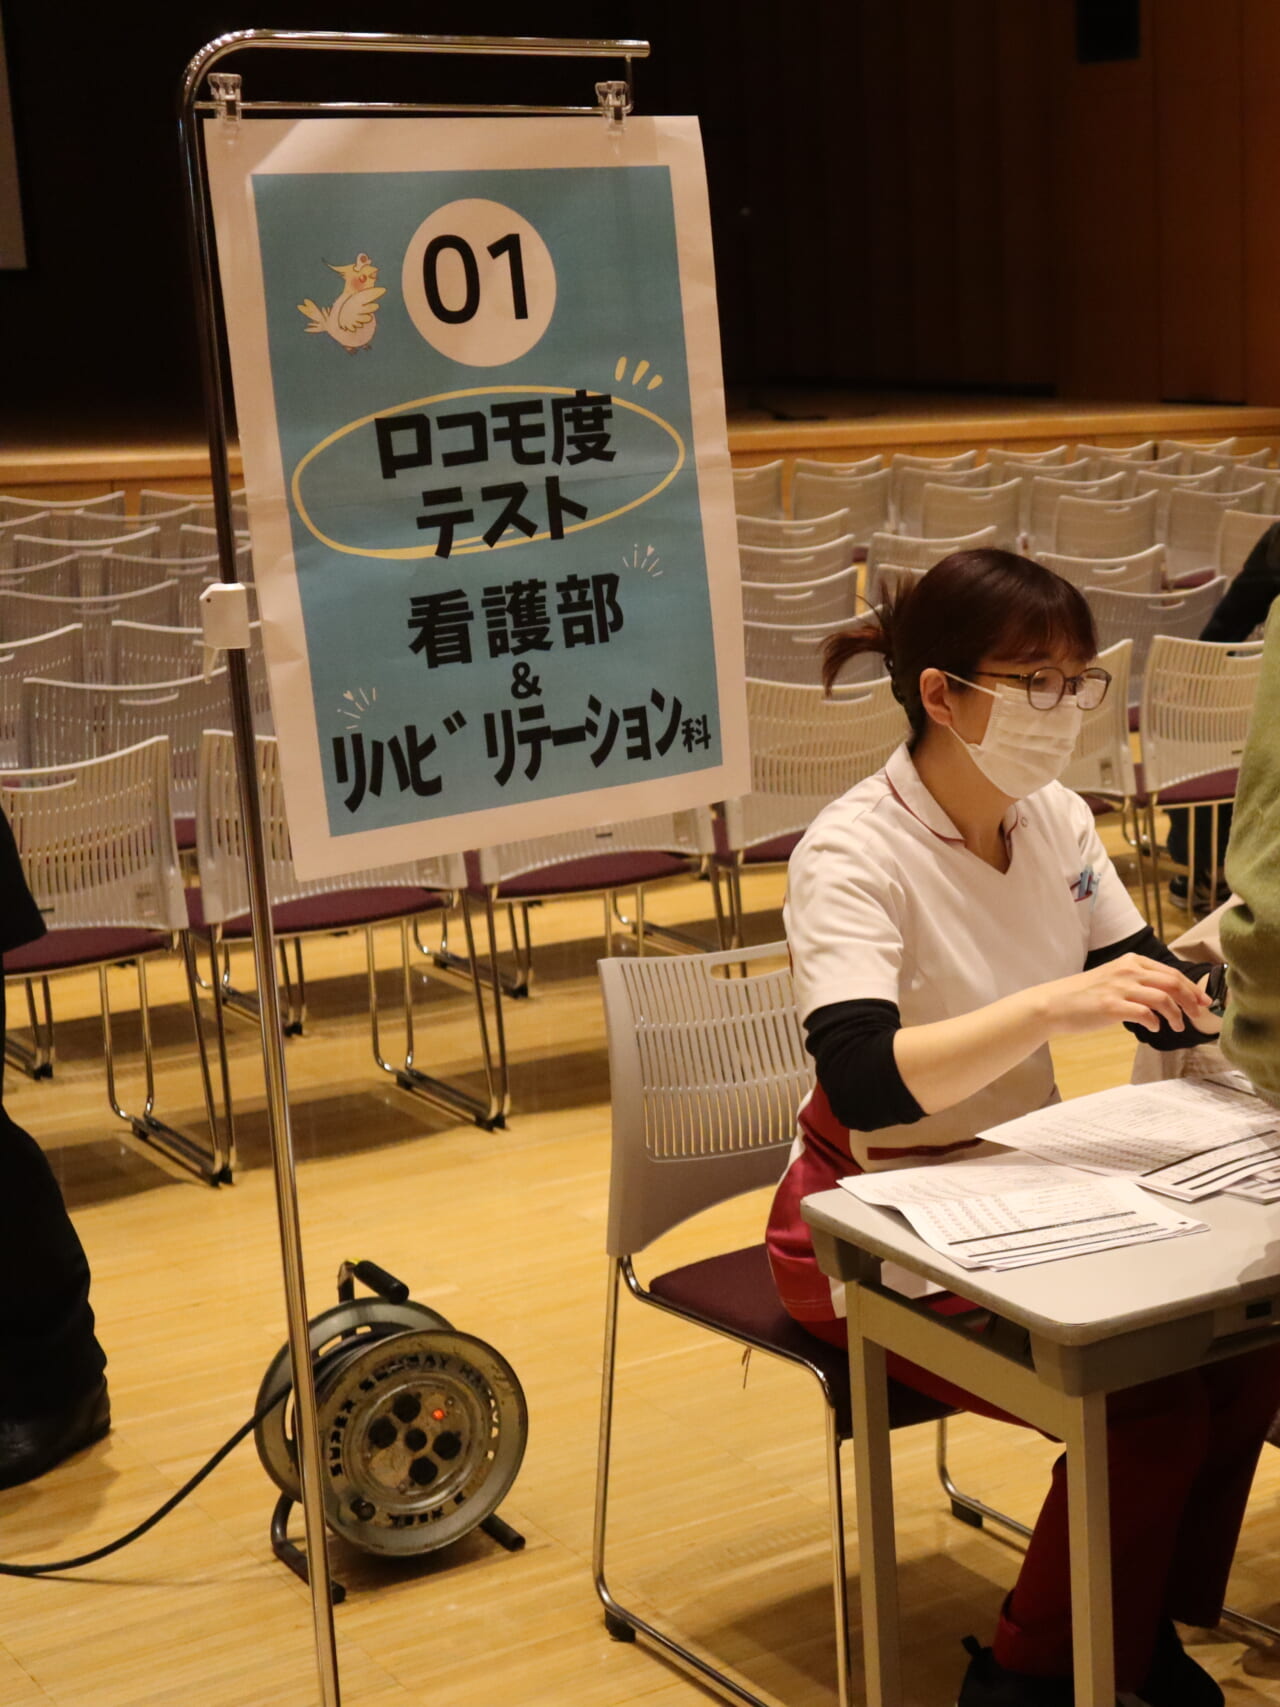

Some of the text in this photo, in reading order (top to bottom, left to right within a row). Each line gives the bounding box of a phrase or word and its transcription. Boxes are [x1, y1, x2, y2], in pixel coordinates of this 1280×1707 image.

[423, 233, 529, 325] 01
[374, 388, 617, 480] ロコモ度
[415, 475, 589, 560] テスト
[407, 572, 625, 669] 看護部
[510, 661, 543, 700] &
